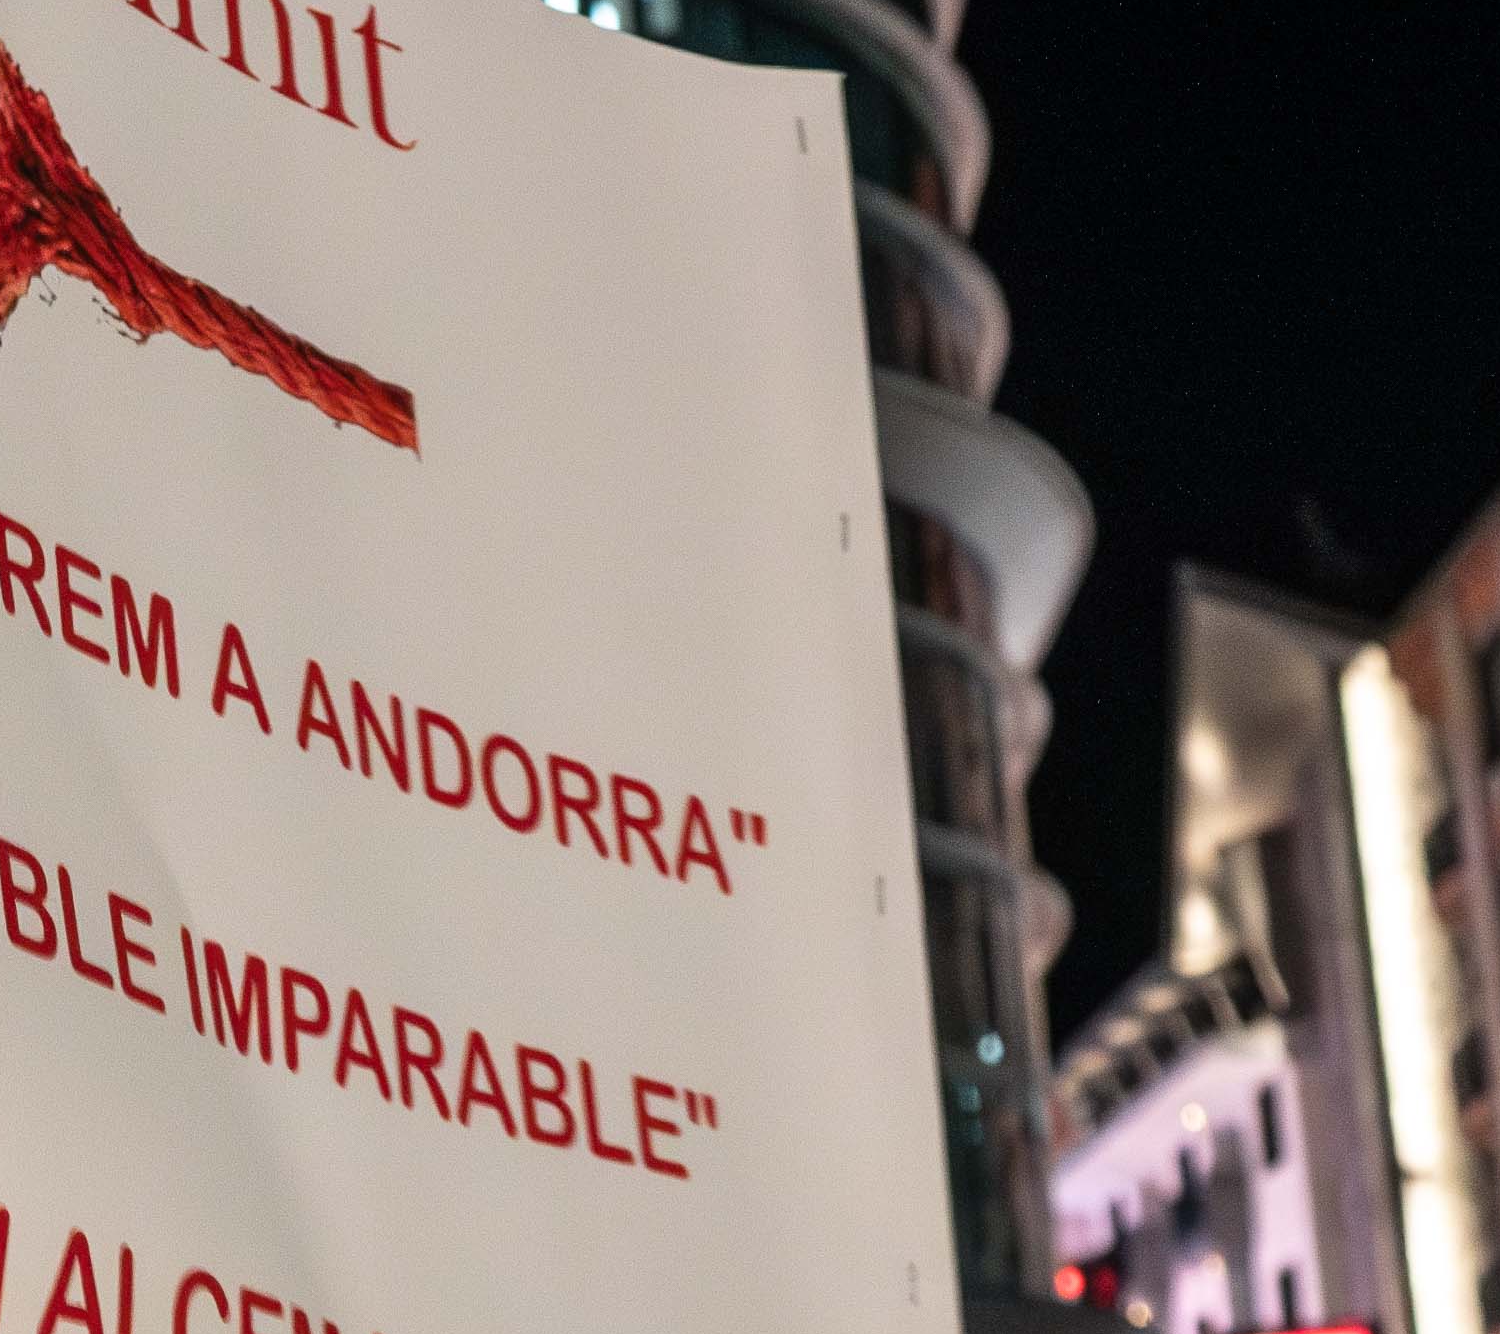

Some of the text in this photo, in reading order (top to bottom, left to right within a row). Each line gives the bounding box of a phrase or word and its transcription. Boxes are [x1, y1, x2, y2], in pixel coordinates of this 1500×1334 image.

[211, 623, 272, 735] A
[295, 659, 768, 895] ANDORRA"
[180, 927, 717, 1180] IMPARABLE"
